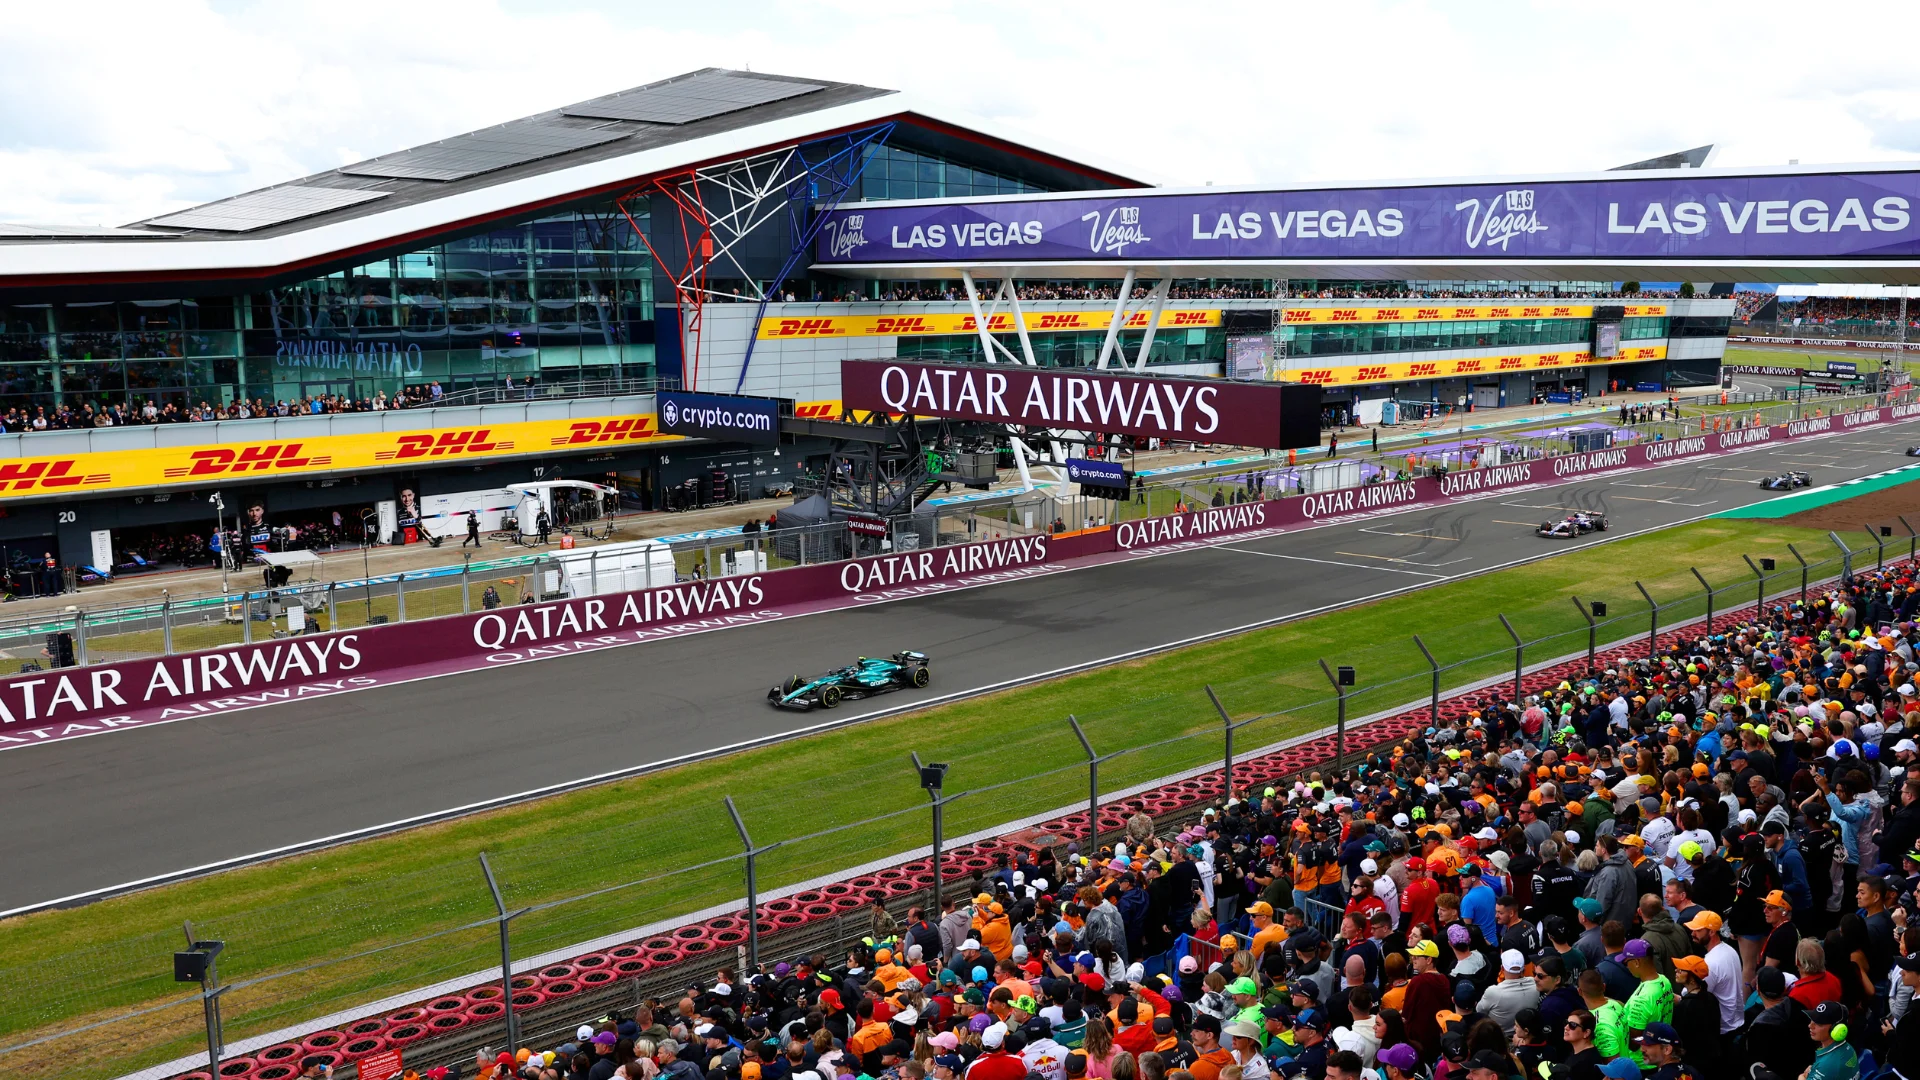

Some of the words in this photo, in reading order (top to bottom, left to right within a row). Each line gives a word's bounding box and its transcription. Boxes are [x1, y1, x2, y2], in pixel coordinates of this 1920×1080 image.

[1506, 190, 1535, 211] LAS
[848, 215, 863, 230] LAS
[1120, 207, 1139, 224] LAS
[1456, 194, 1548, 252] Vegas
[1608, 202, 1706, 234] LAS
[1719, 197, 1910, 233] VEGAS
[1192, 213, 1262, 240] LAS
[1269, 208, 1403, 239] VEGAS
[824, 222, 868, 257] Vegas
[892, 225, 945, 248] LAS
[951, 221, 1042, 246] VEGAS
[1082, 210, 1150, 255] Vegas
[1284, 310, 1311, 322] DHL
[1332, 310, 1358, 321] DHL
[1377, 309, 1400, 320] DHL
[1418, 309, 1438, 319] DHL
[1456, 308, 1475, 318] DHL
[1490, 308, 1509, 317] DHL
[1523, 307, 1540, 316] DHL
[1553, 307, 1569, 316] DHL
[1648, 306, 1661, 314] DHL
[875, 317, 926, 333] DHL
[1039, 314, 1082, 328] DHL
[1174, 312, 1207, 324] DHL
[778, 319, 836, 335] DHL
[1538, 354, 1559, 366] DHL
[1638, 348, 1655, 359] DHL
[1409, 363, 1436, 377] DHL
[1456, 360, 1481, 373] DHL
[1500, 357, 1522, 369] DHL
[1300, 371, 1333, 384] DHL
[1357, 367, 1387, 381] DHL
[1733, 366, 1759, 374] QATAR
[1761, 367, 1796, 376] AIRWAYS
[881, 366, 1010, 415] QATAR
[1021, 375, 1219, 434] AIRWAYS
[682, 406, 770, 431] crypto.com
[795, 404, 835, 421] HL
[1843, 412, 1861, 427] QATAR
[1862, 409, 1879, 423] AIRWAYS
[1892, 405, 1907, 419] QATAR
[568, 418, 654, 444] DHL
[1788, 419, 1808, 436] QATAR
[1809, 416, 1831, 433] AIRWAYS
[395, 430, 496, 459] DHL
[1719, 430, 1744, 449] QATAR
[1745, 426, 1770, 444] AIRWAYS
[1646, 440, 1673, 462] QATAR
[1674, 436, 1705, 456] AIRWAYS
[189, 443, 310, 475] DHL
[660, 455, 670, 465] 16
[1554, 452, 1587, 477] QATAR
[1589, 449, 1627, 470] AIRWAYS
[0, 460, 84, 490] HL
[534, 466, 544, 477] 17
[1081, 470, 1121, 480] crypto.com
[1440, 471, 1481, 496] QATAR
[1483, 463, 1531, 488] AIRWAYS
[1302, 490, 1354, 519] QATAR
[1357, 480, 1416, 509] AIRWAYS
[59, 511, 76, 523] 20
[848, 521, 864, 529] QATAR
[865, 522, 886, 532] AIRWAYS
[1116, 515, 1184, 548] QATAR
[1189, 503, 1266, 536] AIRWAYS
[840, 552, 935, 592] QATAR
[942, 535, 1046, 576] AIRWAYS
[853, 581, 954, 602] QATAR
[957, 563, 1067, 587] AIRWAYS
[473, 598, 608, 650] QATAR
[618, 576, 764, 627] AIRWAYS
[485, 634, 629, 663] QATAR
[637, 609, 783, 639] AIRWAYS
[0, 668, 128, 723] TAR
[143, 635, 361, 701] AIRWAYS
[870, 678, 889, 687] aramco
[0, 715, 144, 743] ATAR
[160, 676, 378, 719] AIRWAYS
[1659, 831, 1674, 840] PETRO
[1445, 856, 1457, 868] 81
[1654, 868, 1660, 882] 4
[1528, 934, 1536, 949] 4
[369, 1055, 398, 1067] TRESPASSING
[1171, 1051, 1189, 1064] NORRIS
[1046, 1062, 1061, 1072] Bull
